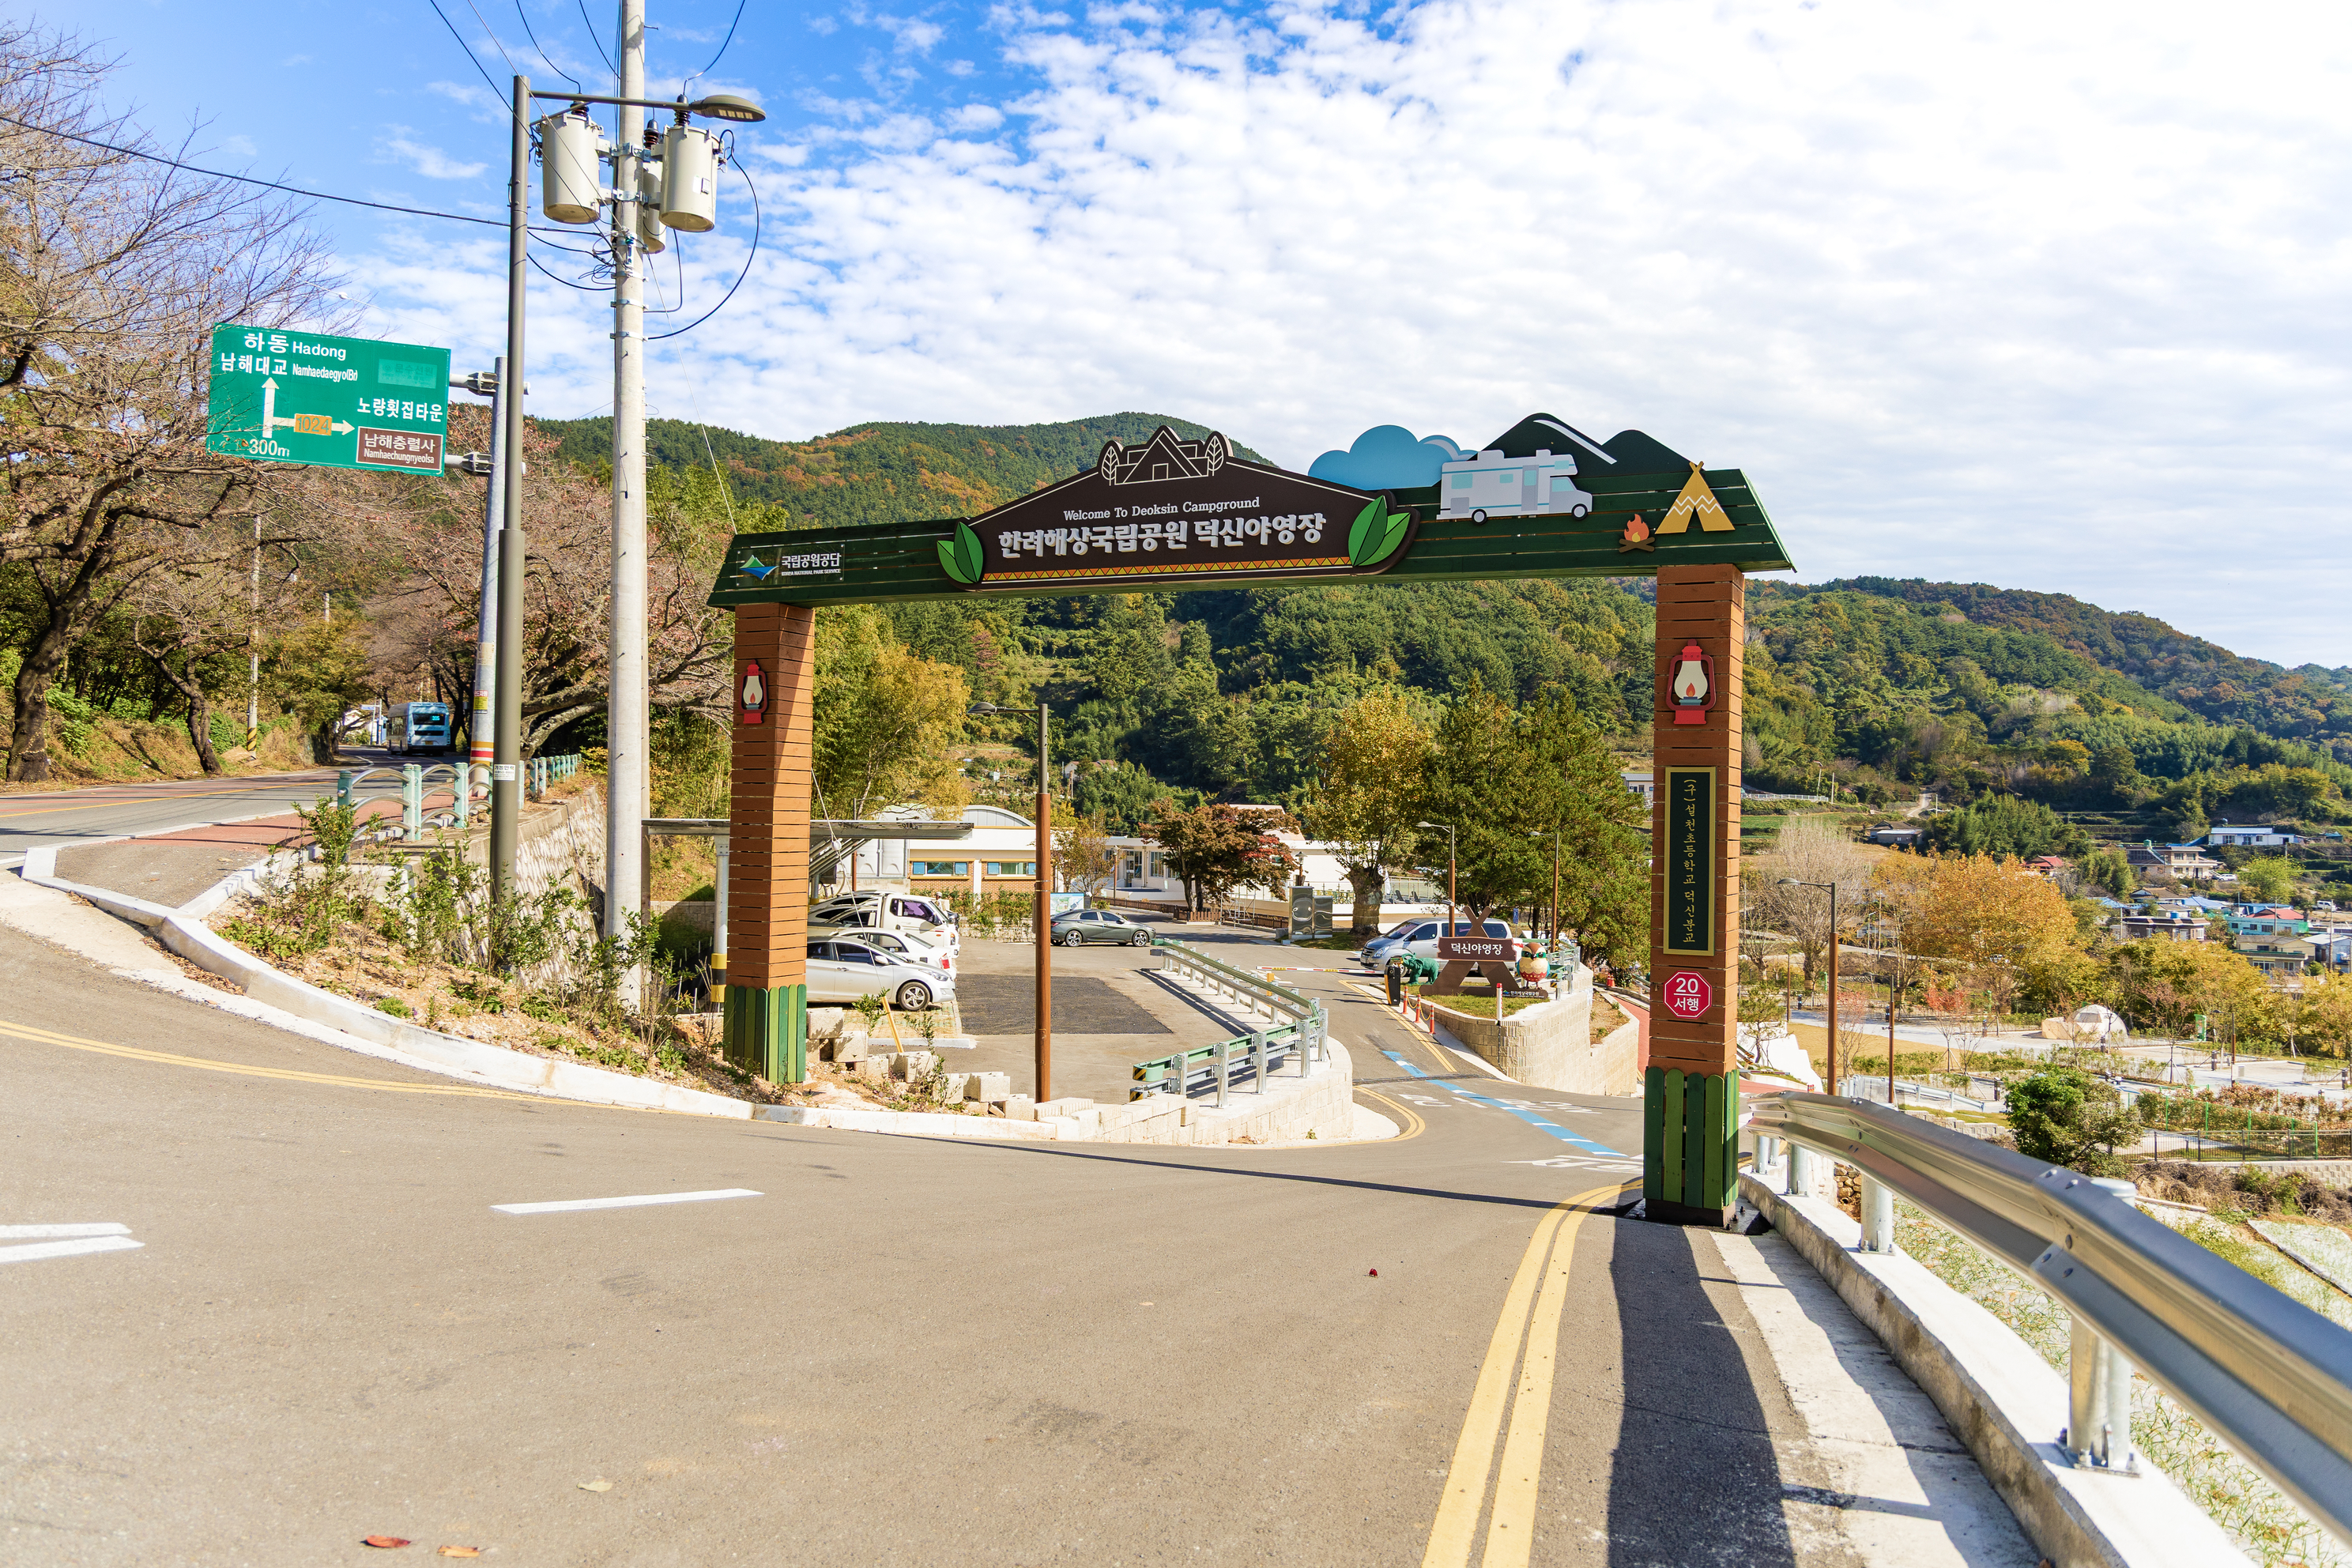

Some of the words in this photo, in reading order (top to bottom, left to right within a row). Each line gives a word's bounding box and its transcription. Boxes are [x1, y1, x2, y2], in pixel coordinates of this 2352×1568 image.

[244, 332, 289, 353] 하동
[292, 341, 346, 361] Hadong
[221, 352, 288, 375] 남해대교
[357, 397, 443, 422] 노량횟집타운
[296, 416, 330, 434] 1024
[249, 438, 290, 458] 300m
[364, 433, 435, 453] 남해충렬사
[364, 448, 435, 465] Namhaechungnyeolsa
[1063, 509, 1111, 521] Welcome
[1114, 507, 1129, 518] To
[1132, 503, 1178, 516] Deoksin
[1182, 496, 1260, 514] Campground
[998, 520, 1188, 559] 한려해상국립공원
[1193, 512, 1327, 548] 덕신야영장
[781, 553, 842, 569] 국립공원공단
[1683, 779, 1697, 884] (구)설천초등학교
[1683, 889, 1696, 944] 덕신분교
[1450, 943, 1503, 956] 덕신야영장
[1675, 978, 1699, 994] 20
[1674, 997, 1699, 1012] 서행
